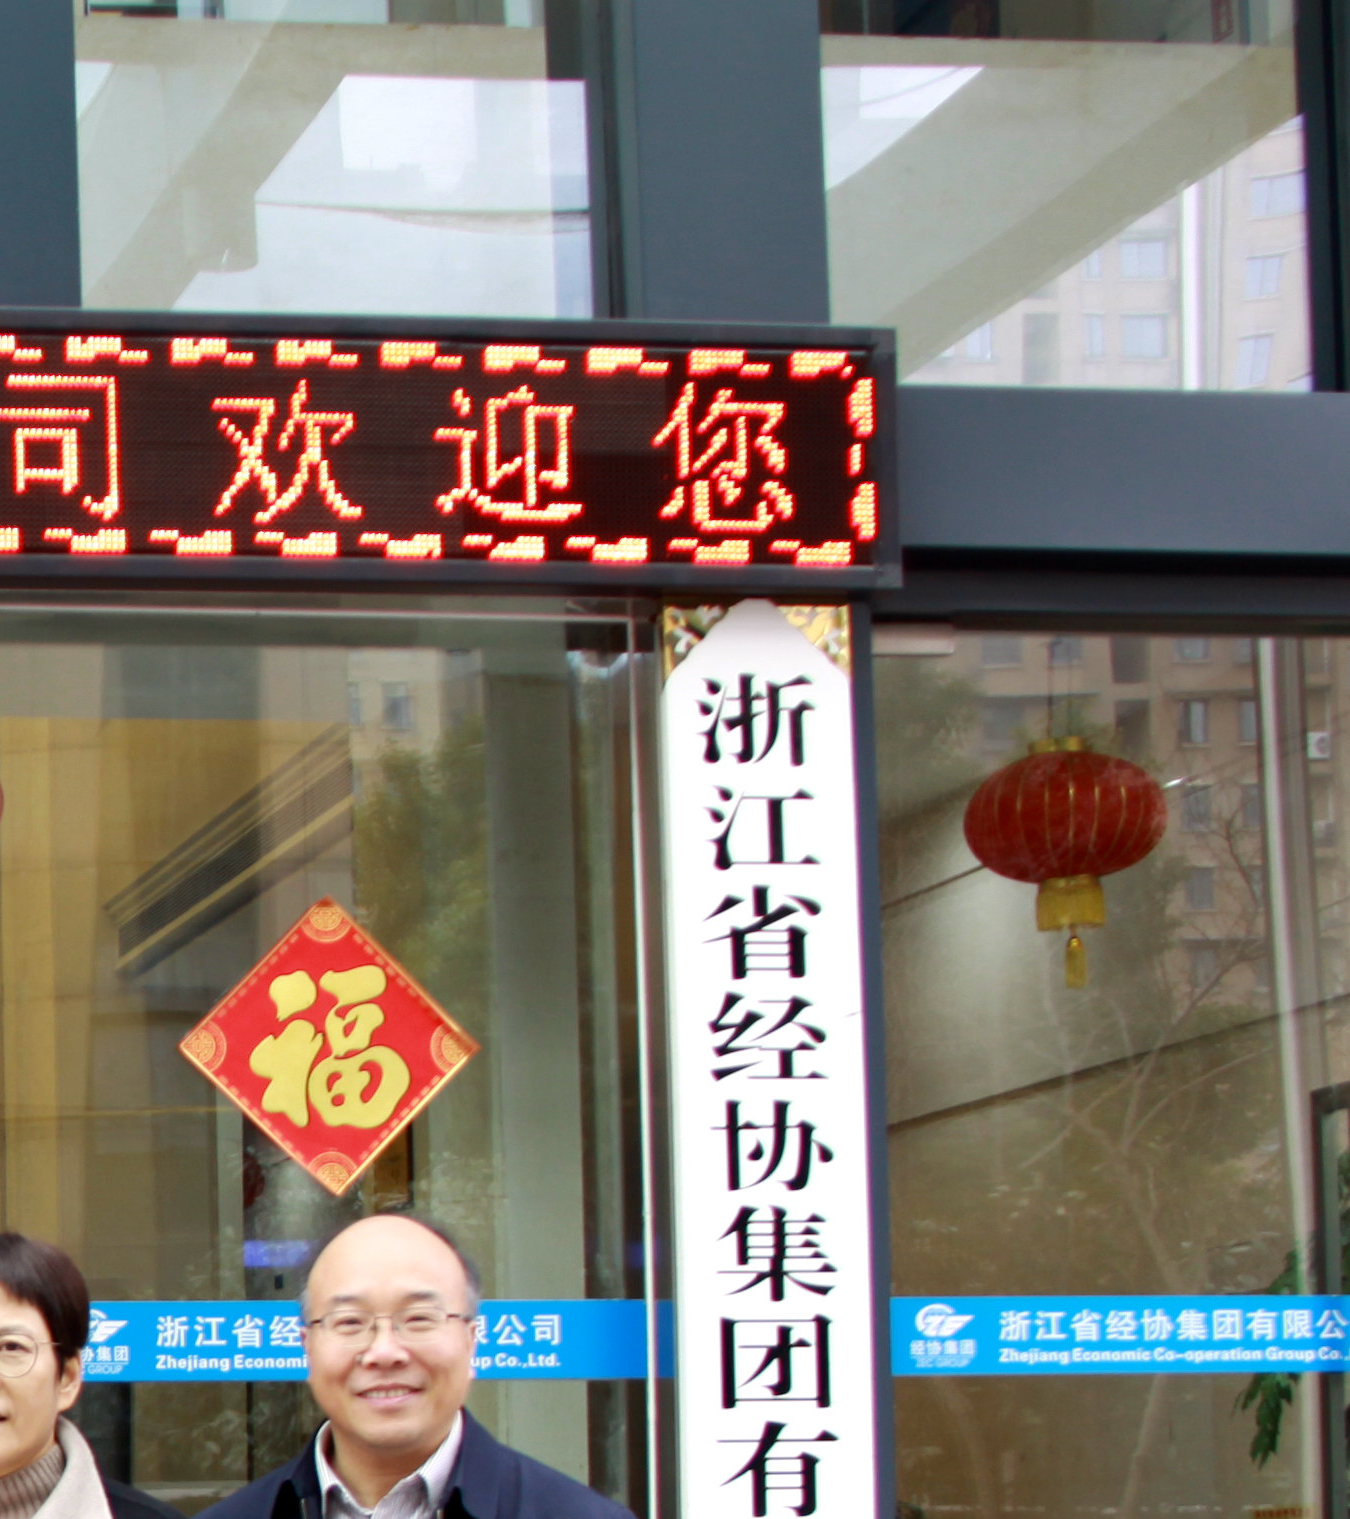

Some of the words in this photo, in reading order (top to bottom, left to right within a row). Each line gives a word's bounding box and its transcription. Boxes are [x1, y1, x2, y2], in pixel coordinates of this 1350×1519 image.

[249, 965, 410, 1128] 福
[155, 1354, 231, 1372] Zhejiang
[234, 1353, 308, 1369] Economi
[999, 1347, 1069, 1364] Zhejiang
[1072, 1346, 1151, 1362] Economic
[1265, 1345, 1317, 1364] Group
